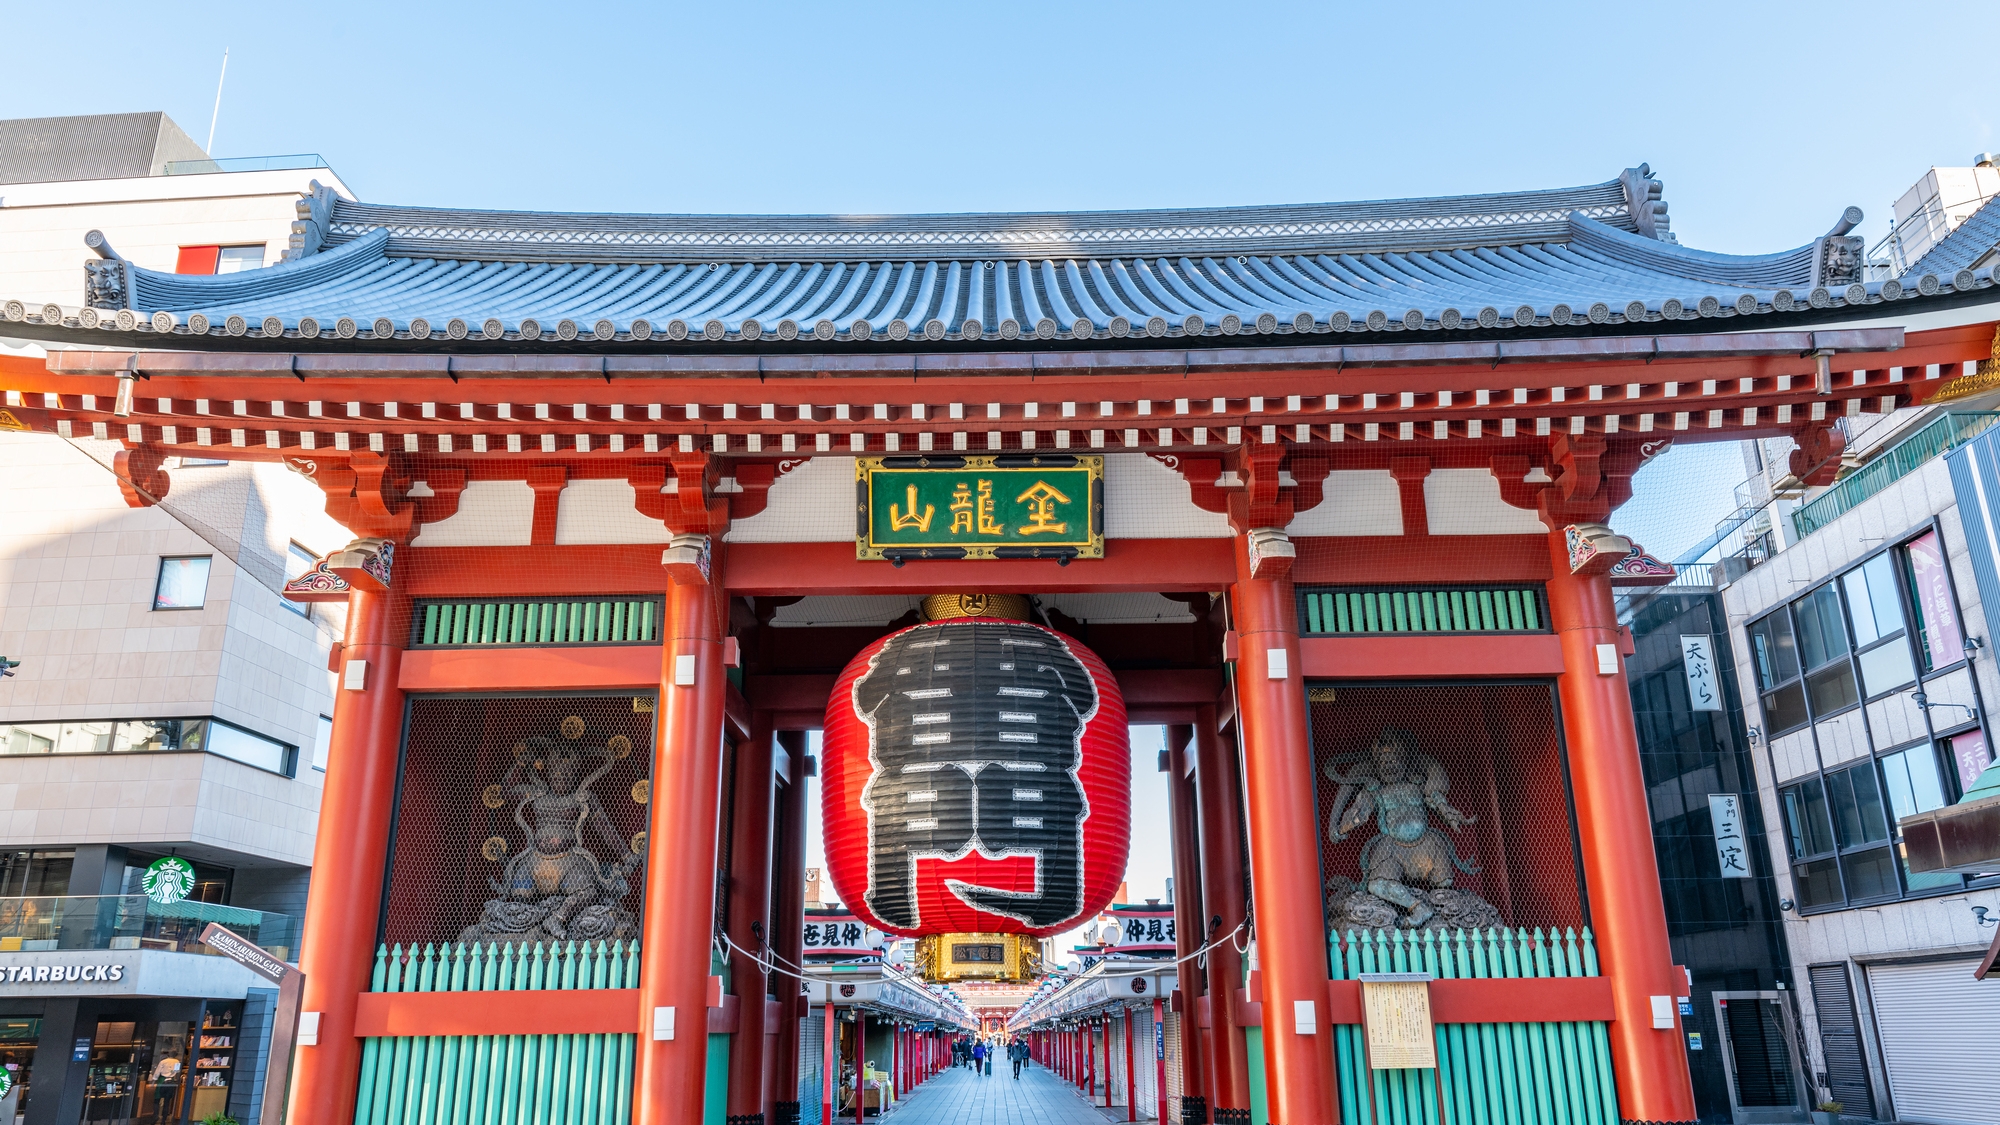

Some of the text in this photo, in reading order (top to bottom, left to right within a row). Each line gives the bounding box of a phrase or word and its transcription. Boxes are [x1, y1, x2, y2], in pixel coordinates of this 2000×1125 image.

[1686, 643, 1712, 704] 天ぷら
[1962, 751, 1977, 784] 天ぷ
[1718, 823, 1746, 871] 三定
[214, 932, 265, 964] KAMINARIMON
[264, 958, 284, 975] GATE
[955, 947, 1002, 961] 松下電器
